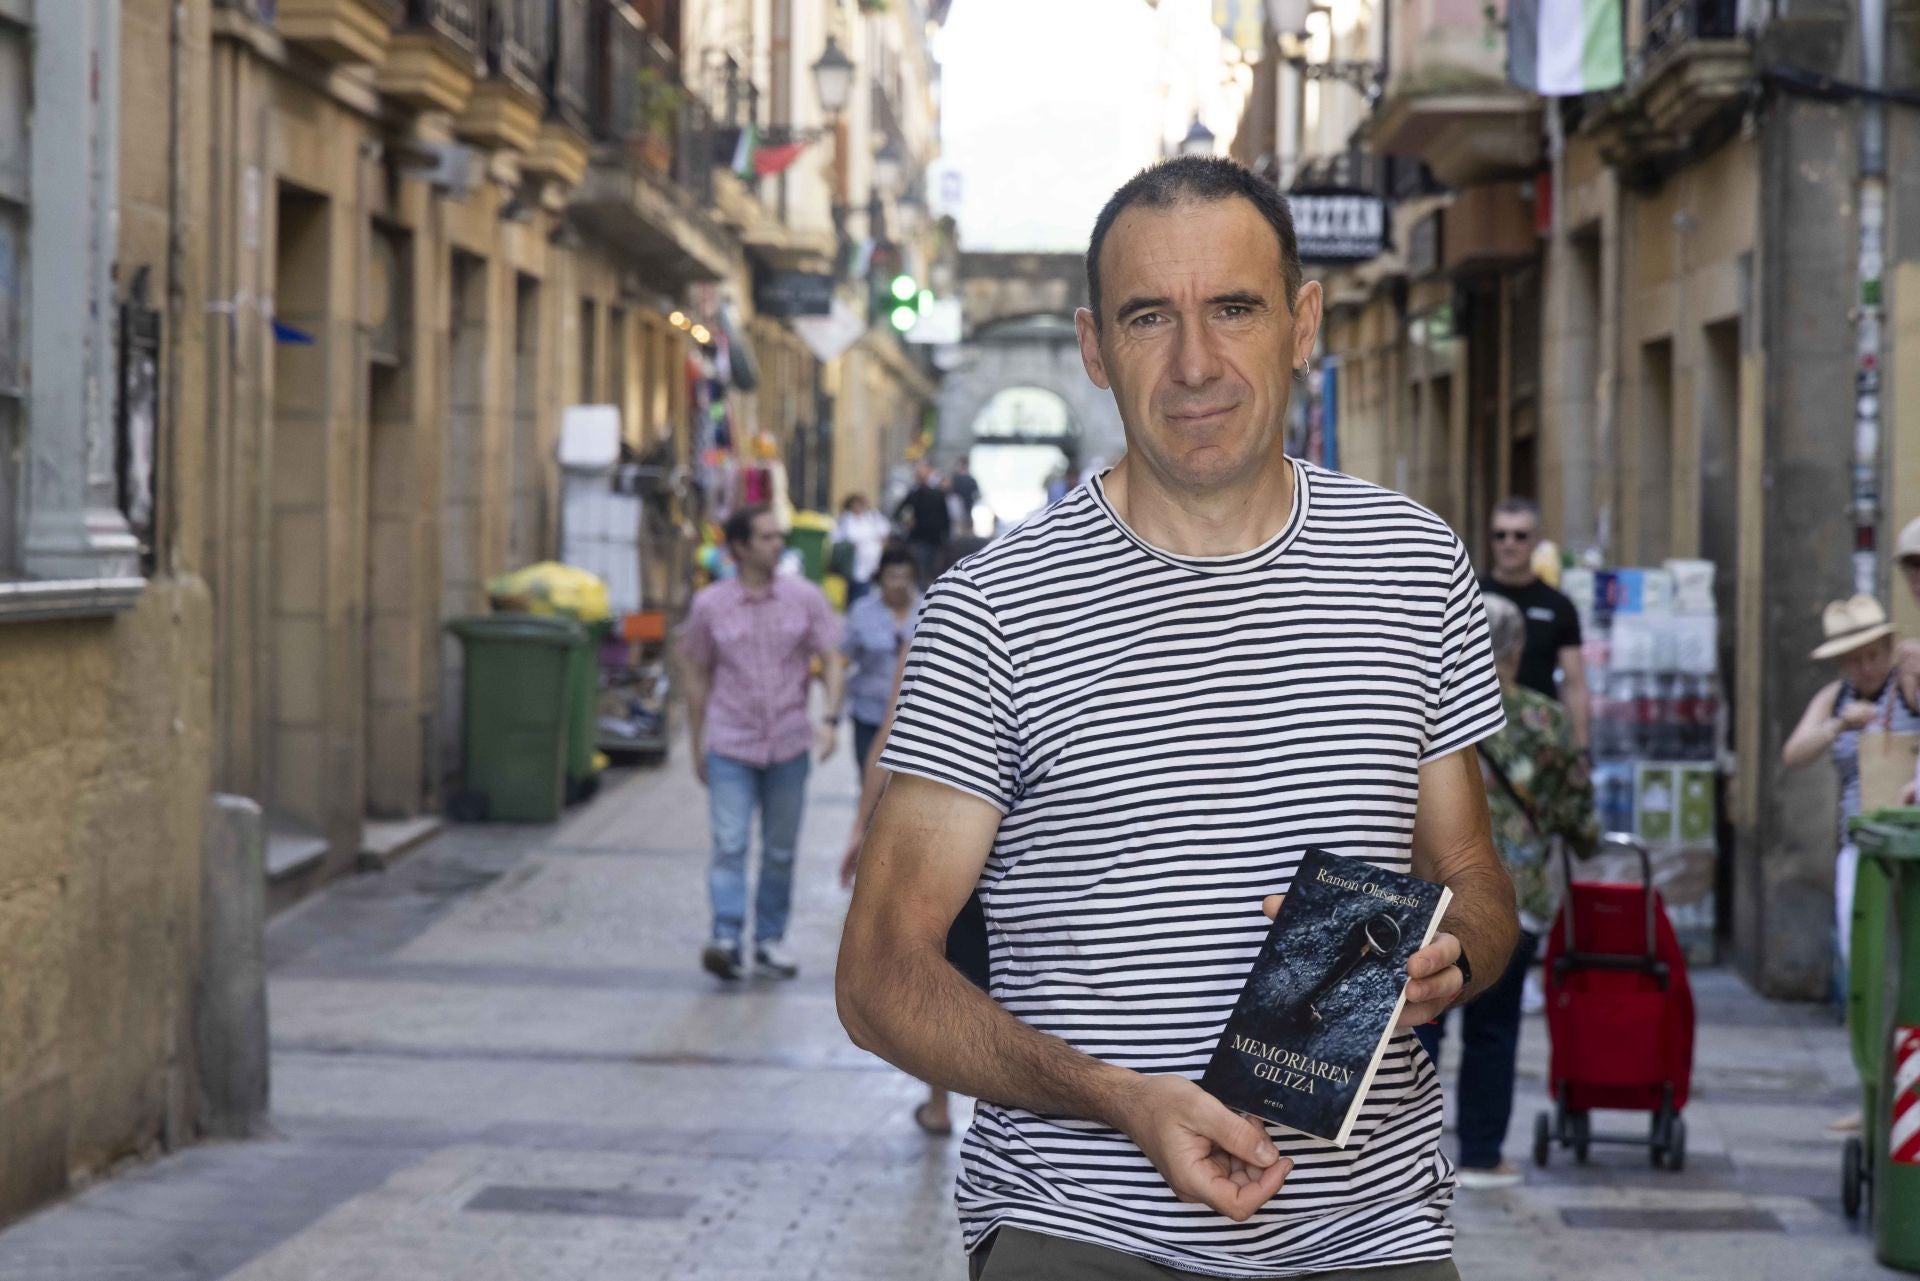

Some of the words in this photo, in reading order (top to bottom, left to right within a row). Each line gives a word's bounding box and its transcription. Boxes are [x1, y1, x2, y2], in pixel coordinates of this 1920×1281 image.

[1316, 868, 1360, 891] Ramon
[1362, 882, 1420, 908] Olasagasti
[1230, 1034, 1355, 1085] MEMORIAREN
[1253, 1062, 1315, 1094] GILTZA
[1263, 1098, 1284, 1110] erein
